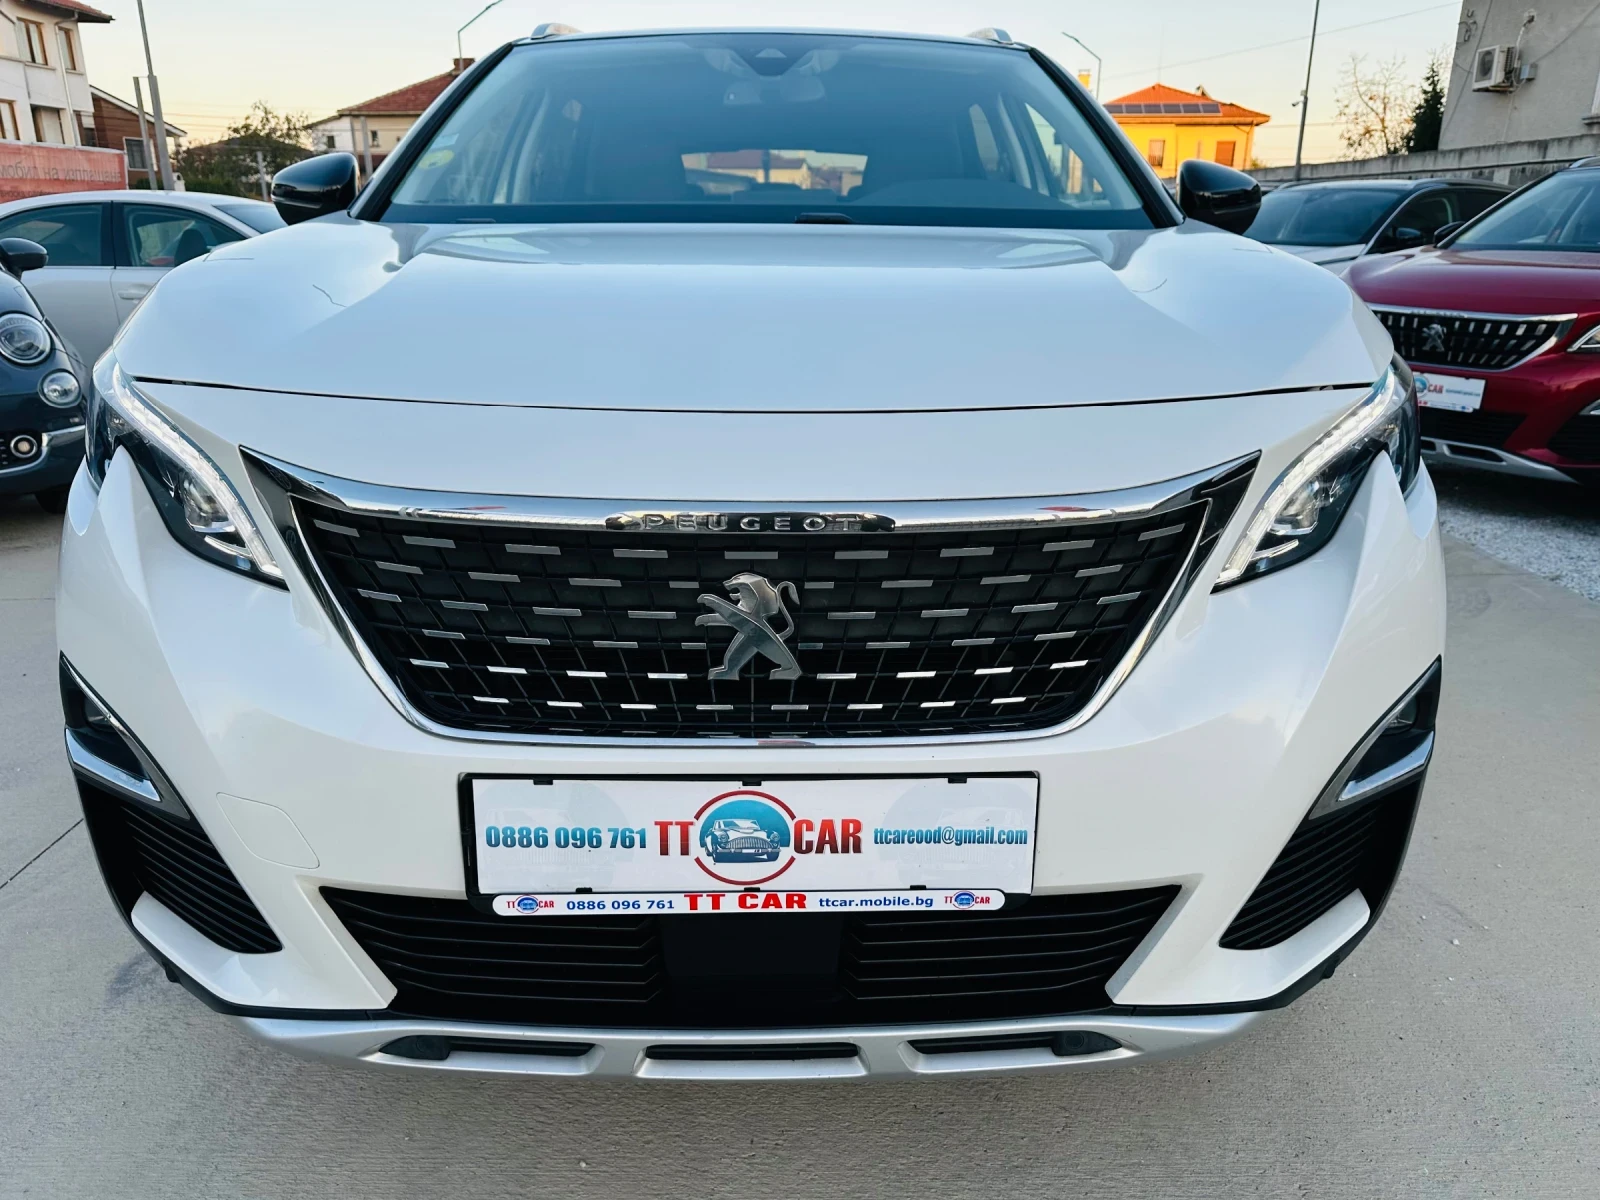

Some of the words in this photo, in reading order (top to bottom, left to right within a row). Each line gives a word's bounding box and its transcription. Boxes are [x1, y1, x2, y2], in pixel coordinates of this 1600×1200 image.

[44, 167, 59, 181] на
[643, 513, 858, 531] PEUGEOT
[485, 826, 549, 849] 0886
[554, 827, 603, 849] 096
[607, 828, 647, 849] 761
[654, 820, 695, 857] TT
[793, 818, 863, 855] CAR
[873, 825, 1028, 847] ttcareood@gmail.com
[506, 900, 516, 909] TT
[538, 900, 555, 909] CAR
[566, 900, 606, 911] 0886
[611, 900, 641, 911] 096
[646, 900, 675, 910] 761
[684, 894, 726, 911] TT
[737, 893, 807, 910] CAR
[818, 896, 934, 908] ttcar.mobile.bg
[944, 896, 953, 905] TT
[974, 896, 991, 905] CAR
